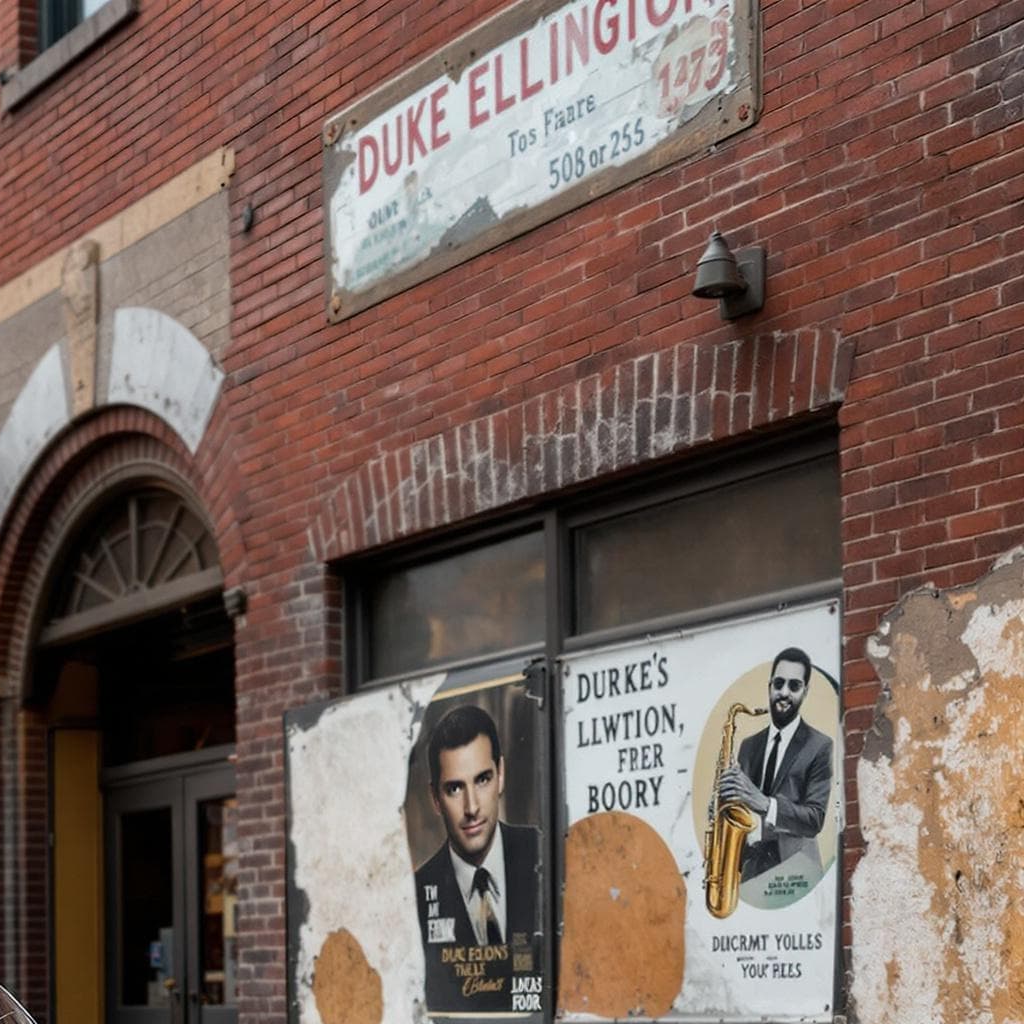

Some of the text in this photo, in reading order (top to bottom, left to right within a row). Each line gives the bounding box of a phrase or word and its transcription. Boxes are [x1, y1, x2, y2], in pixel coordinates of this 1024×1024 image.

[358, 0, 696, 196] DUKE ELLINGT
[589, 144, 607, 169] or
[610, 117, 645, 160] 255
[577, 652, 668, 703] DURKE'S
[577, 703, 684, 748] LLWTION,
[588, 775, 664, 814] BOORY
[774, 932, 823, 951] YOLLES
